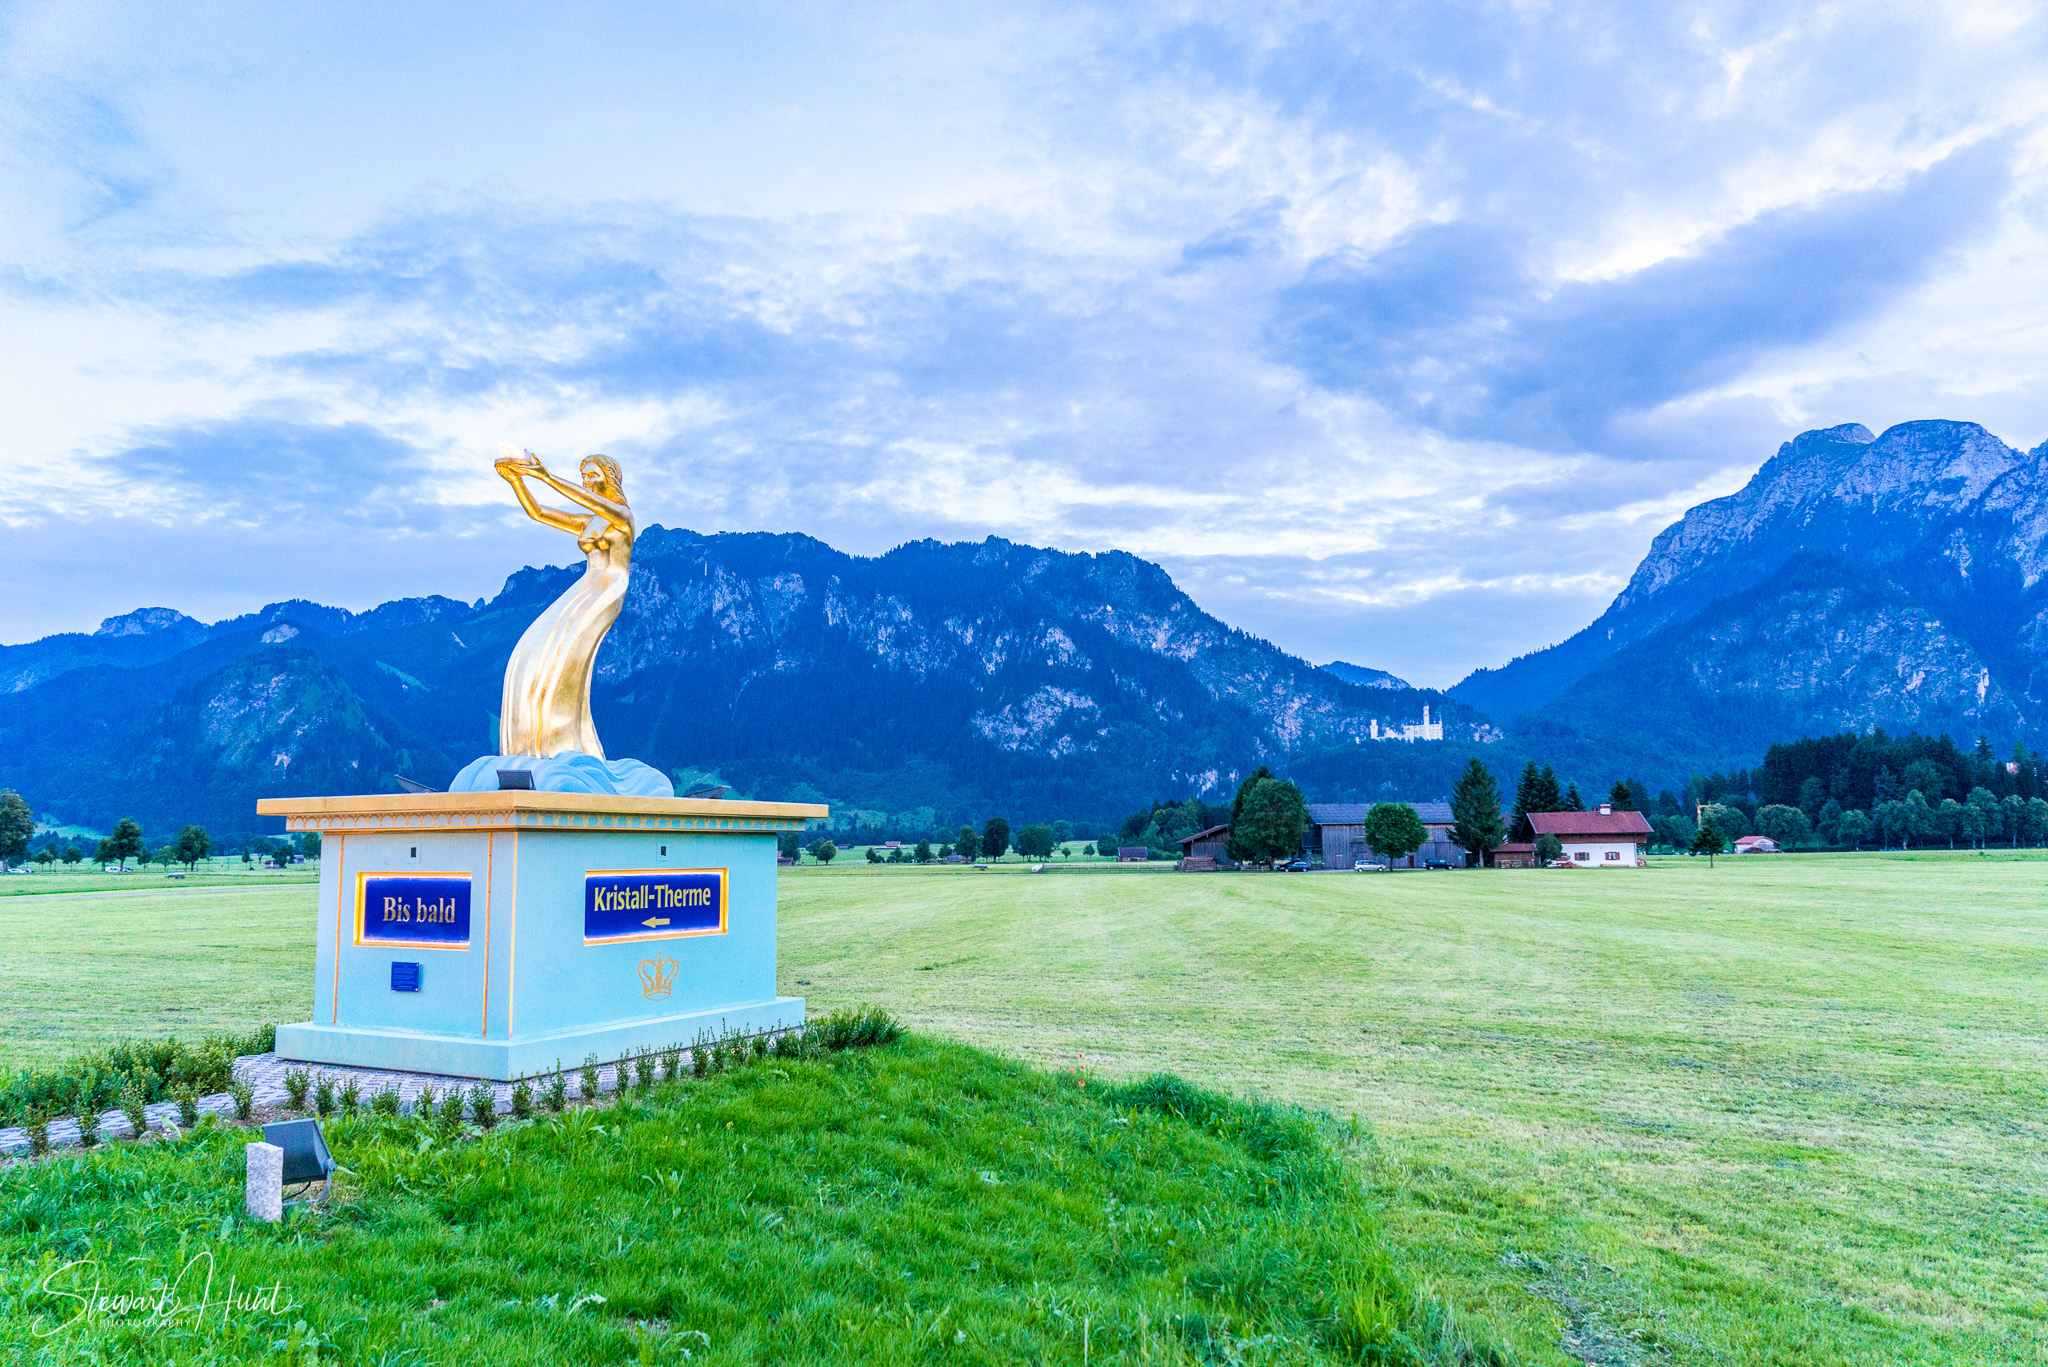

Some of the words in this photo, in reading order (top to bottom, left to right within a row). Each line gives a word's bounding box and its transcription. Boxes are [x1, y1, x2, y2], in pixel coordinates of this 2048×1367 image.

[382, 896, 411, 922] Bis
[416, 897, 456, 923] bald
[594, 884, 711, 911] Kristall-Therme
